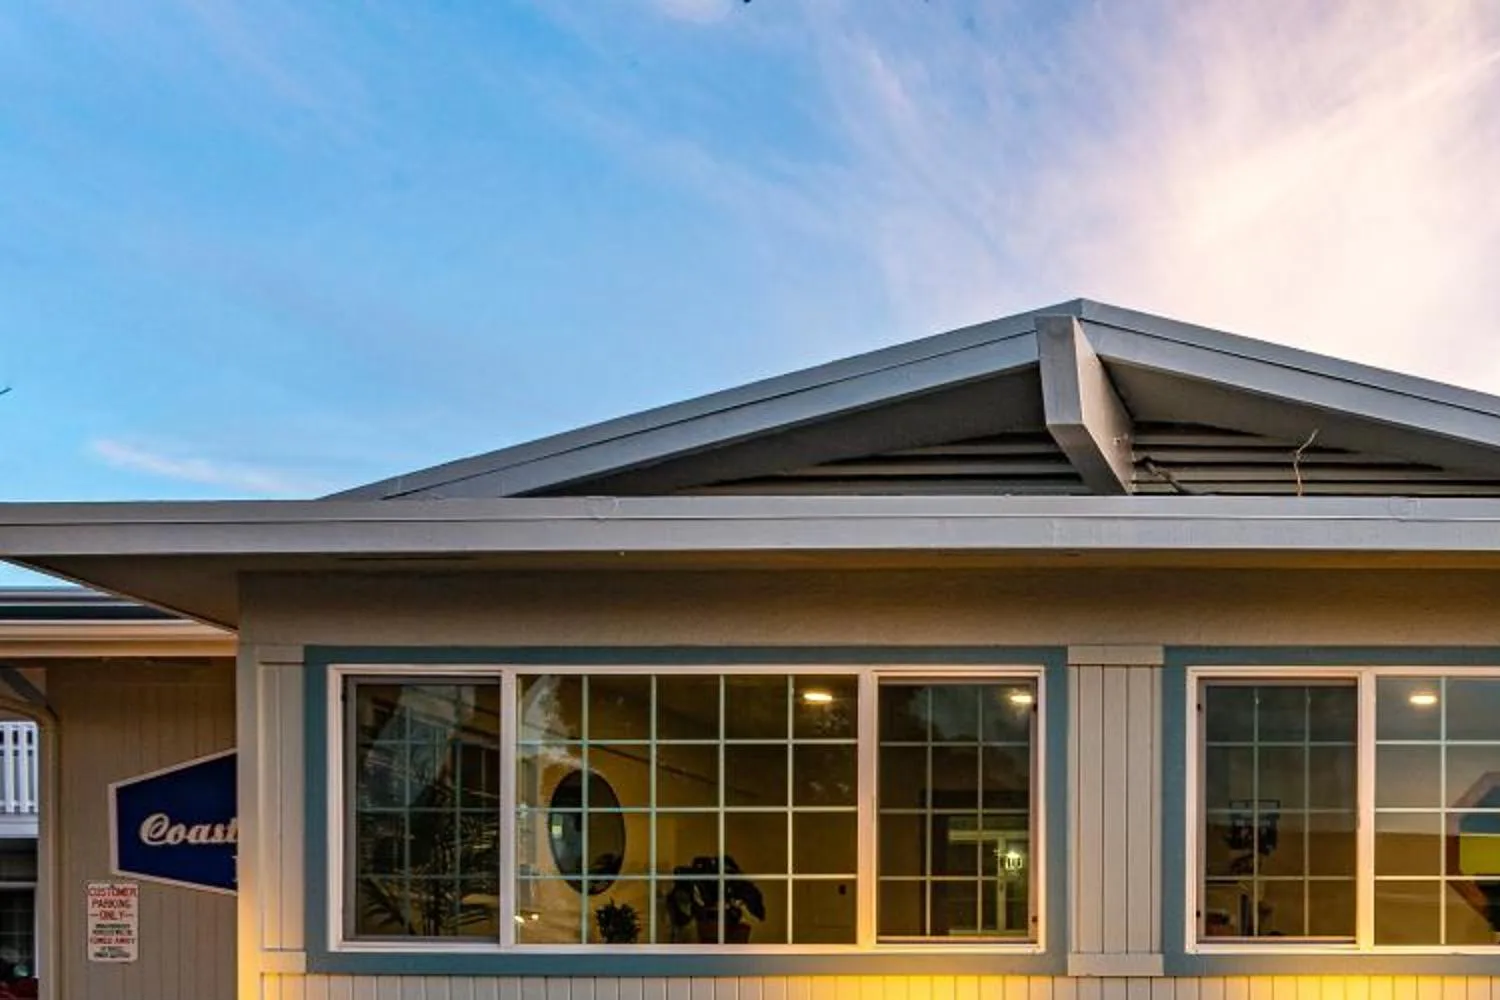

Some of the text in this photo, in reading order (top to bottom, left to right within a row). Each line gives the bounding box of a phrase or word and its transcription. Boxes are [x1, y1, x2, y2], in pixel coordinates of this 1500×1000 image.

[139, 812, 239, 846] Coast
[90, 888, 137, 897] CUSTOMER
[92, 899, 131, 908] PARKING
